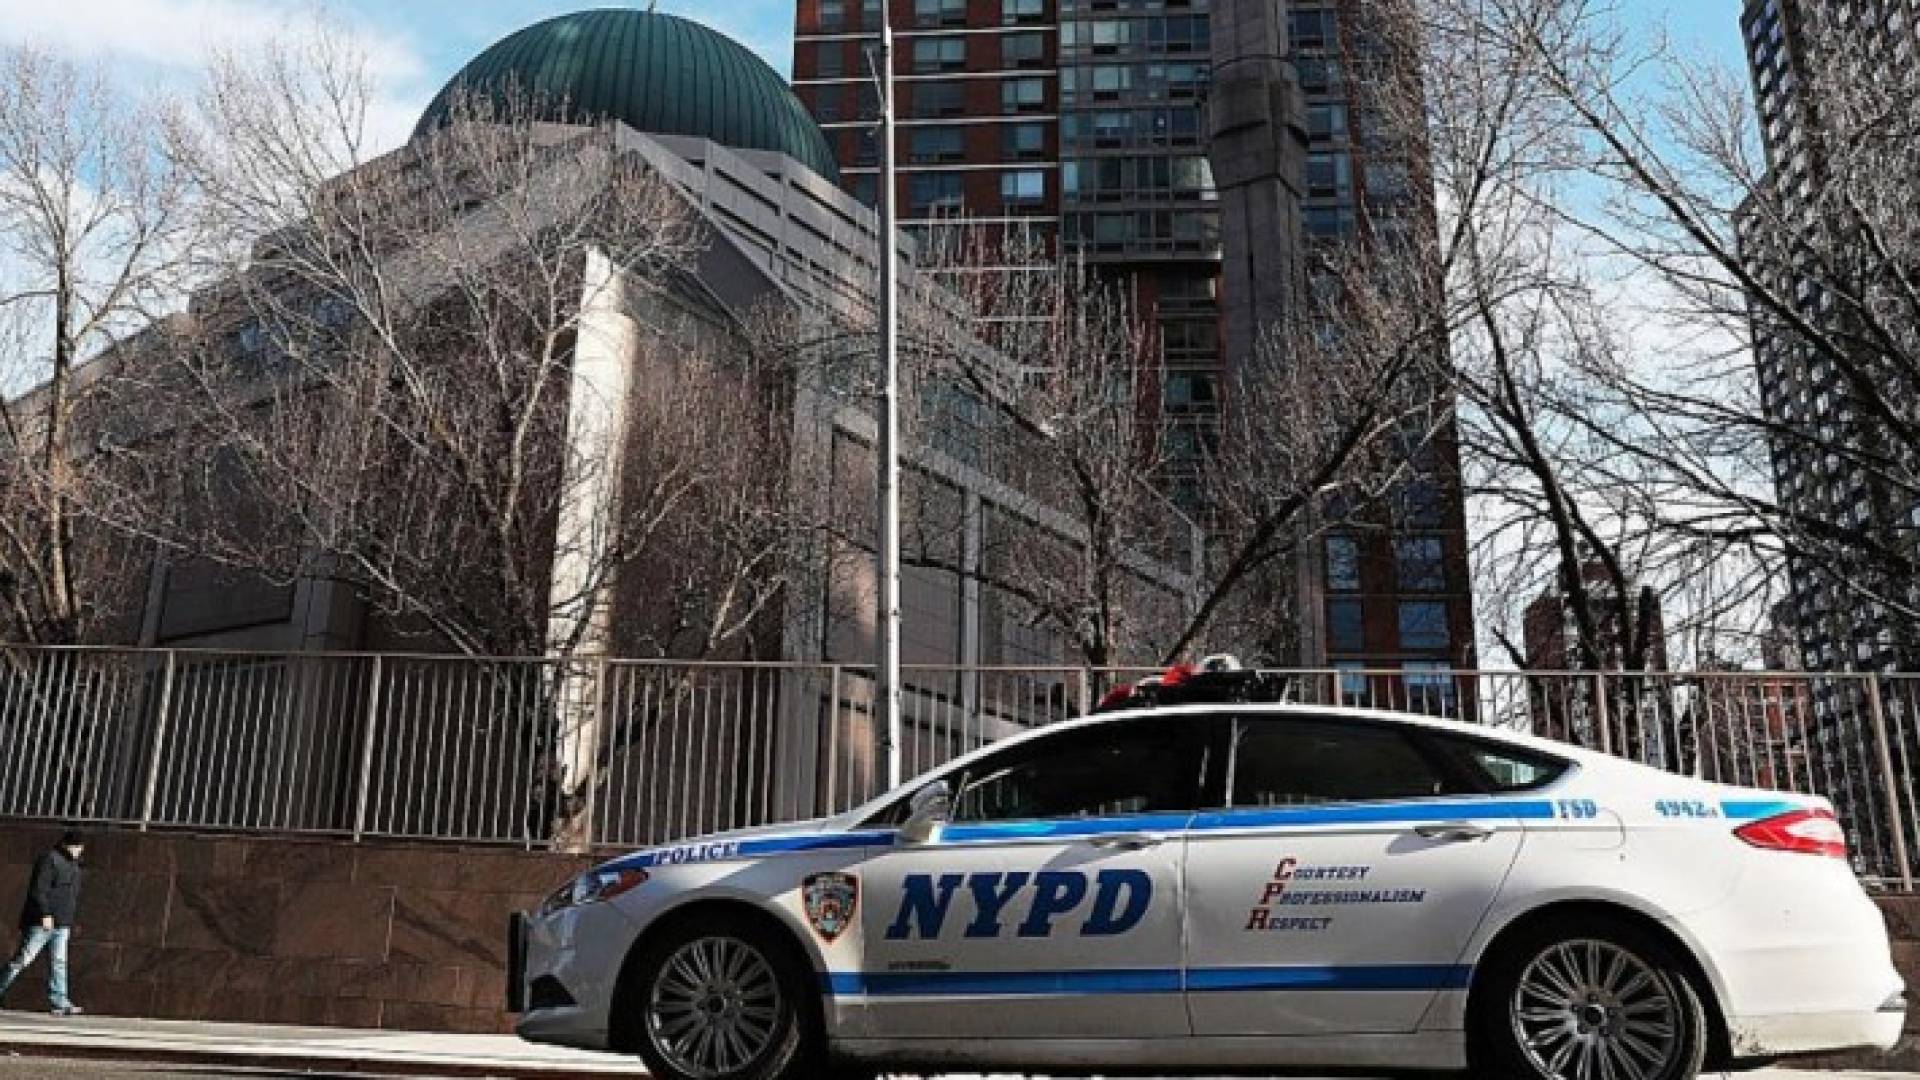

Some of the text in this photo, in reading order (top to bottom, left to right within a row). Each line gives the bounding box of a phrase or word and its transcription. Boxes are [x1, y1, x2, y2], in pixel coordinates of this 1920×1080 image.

[655, 842, 738, 864] POLICE
[1274, 857, 1370, 881] COURTESY
[885, 869, 1154, 940] NYPD
[1259, 882, 1426, 905] PROFESSIONALISM
[1244, 908, 1333, 931] RESPECT
